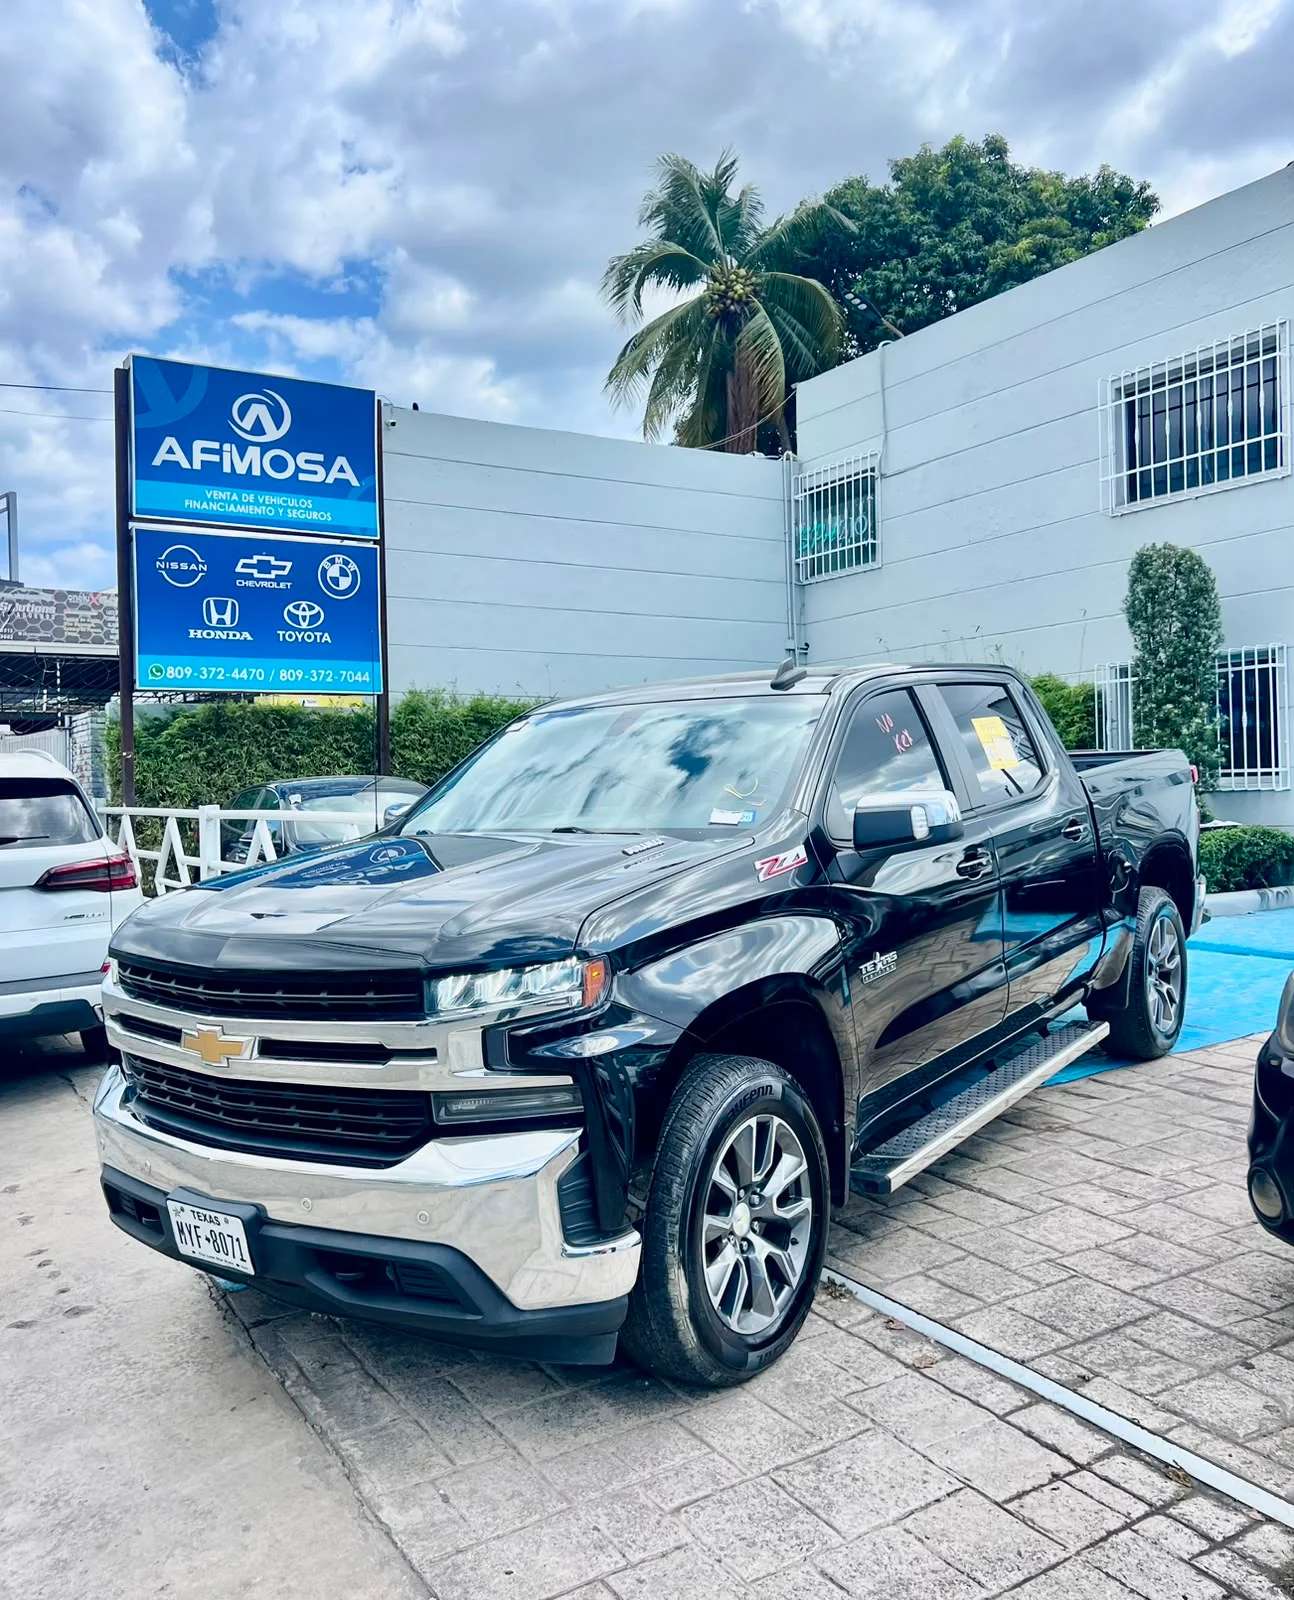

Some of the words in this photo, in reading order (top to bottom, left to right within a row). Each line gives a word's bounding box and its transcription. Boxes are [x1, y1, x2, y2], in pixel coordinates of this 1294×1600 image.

[205, 489, 238, 502] VENTA
[242, 493, 255, 503] DE
[257, 494, 312, 508] VEHICULOS
[185, 499, 274, 516] FINANCIAMIENTO
[277, 506, 284, 517] Y
[287, 509, 332, 521] SEGUROS
[156, 560, 208, 572] NISSAN
[236, 579, 292, 589] CHEVROLET
[188, 629, 253, 641] HONDA
[276, 630, 331, 643] TOYOTA
[166, 666, 265, 681] 809-372-4470
[279, 671, 370, 683] 809-372-7044
[858, 951, 898, 974] TEXAS
[190, 1209, 221, 1226] TEXAS
